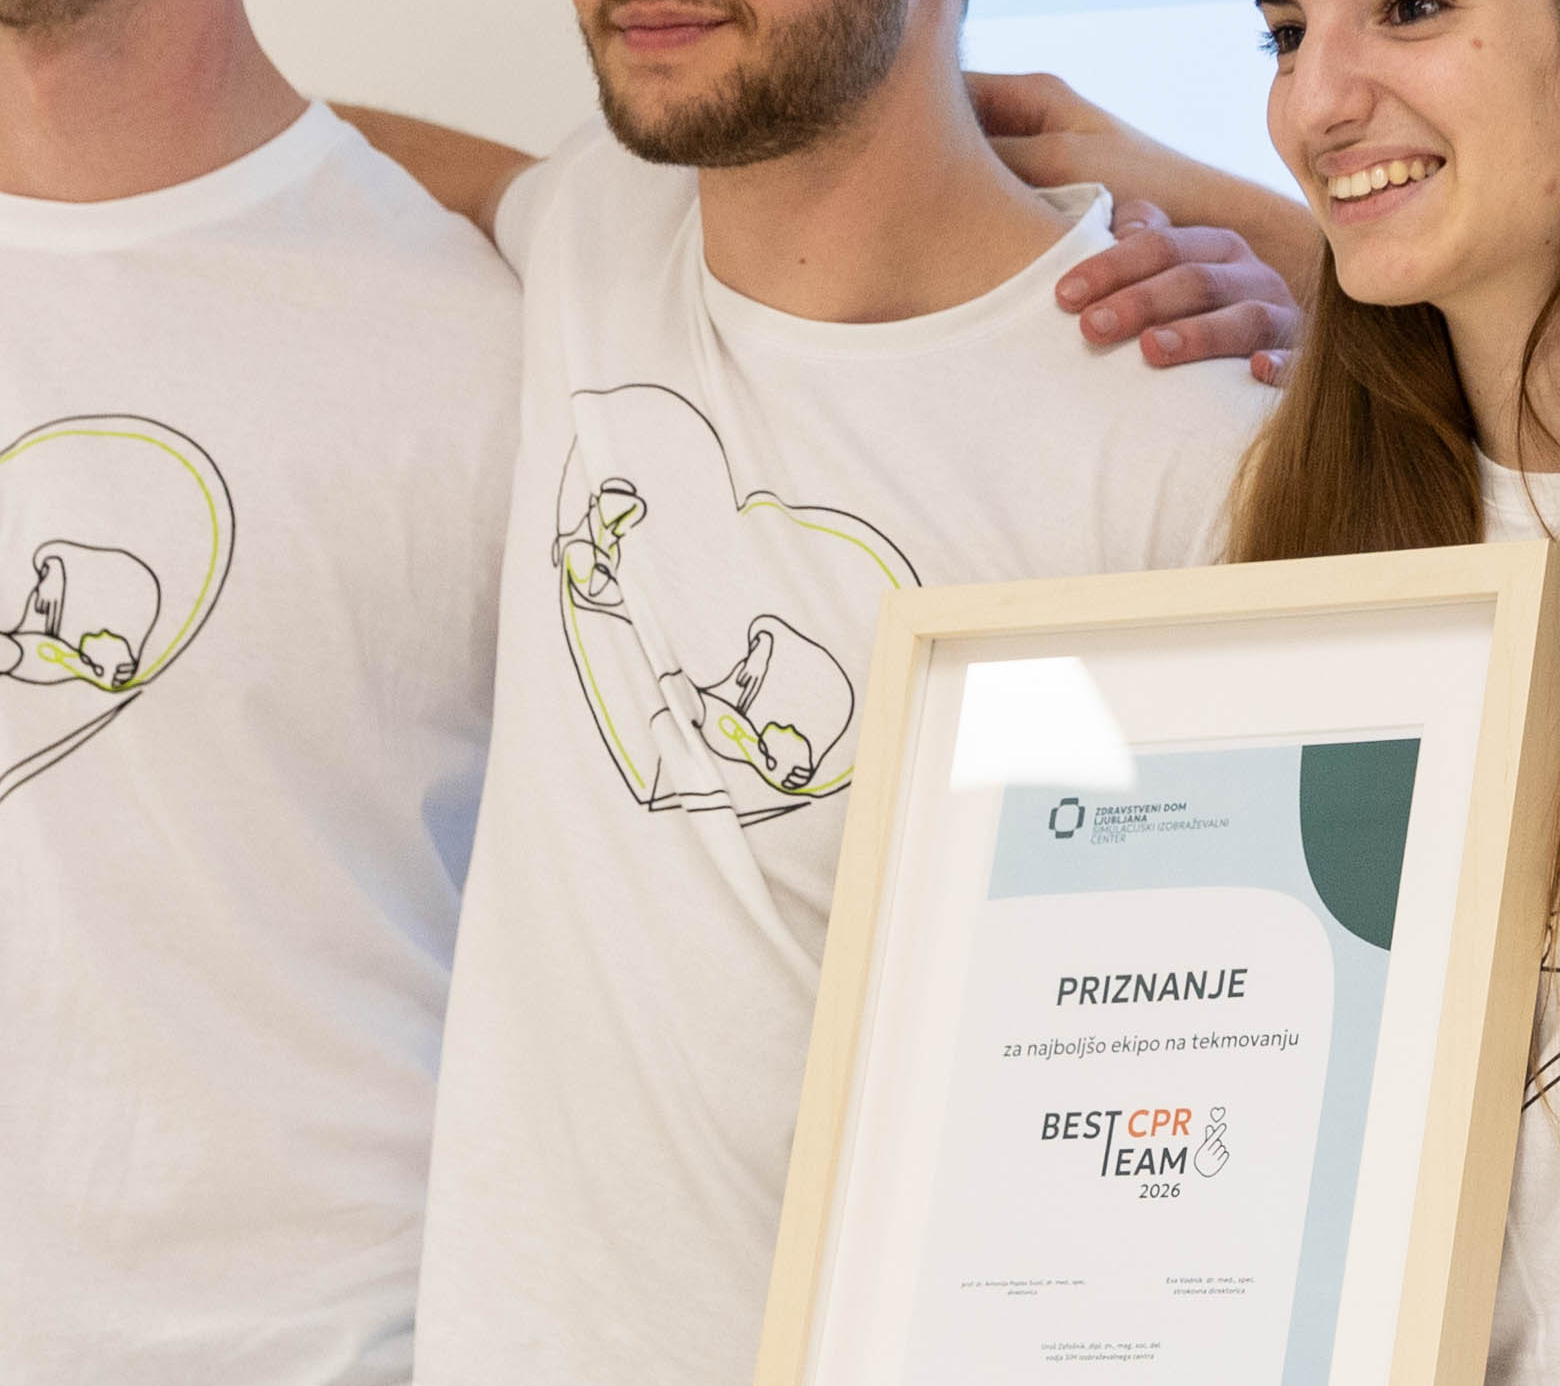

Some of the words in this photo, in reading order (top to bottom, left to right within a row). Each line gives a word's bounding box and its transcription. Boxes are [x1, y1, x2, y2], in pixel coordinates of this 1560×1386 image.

[1094, 814, 1148, 826] LJUBLJANA
[1095, 805, 1161, 816] ZDRAVSTVENI
[1163, 802, 1188, 812] DOM
[1056, 968, 1247, 1006] PRIZNANJE
[1003, 1044, 1022, 1057] za
[1027, 1036, 1106, 1060] najboljšo
[1111, 1033, 1160, 1056] ekipo
[1165, 1037, 1186, 1050] na
[1192, 1029, 1299, 1052] tekmovanju
[1041, 1110, 1123, 1154] BEST
[1127, 1108, 1193, 1138] CPR
[1139, 1182, 1181, 1199] 2026
